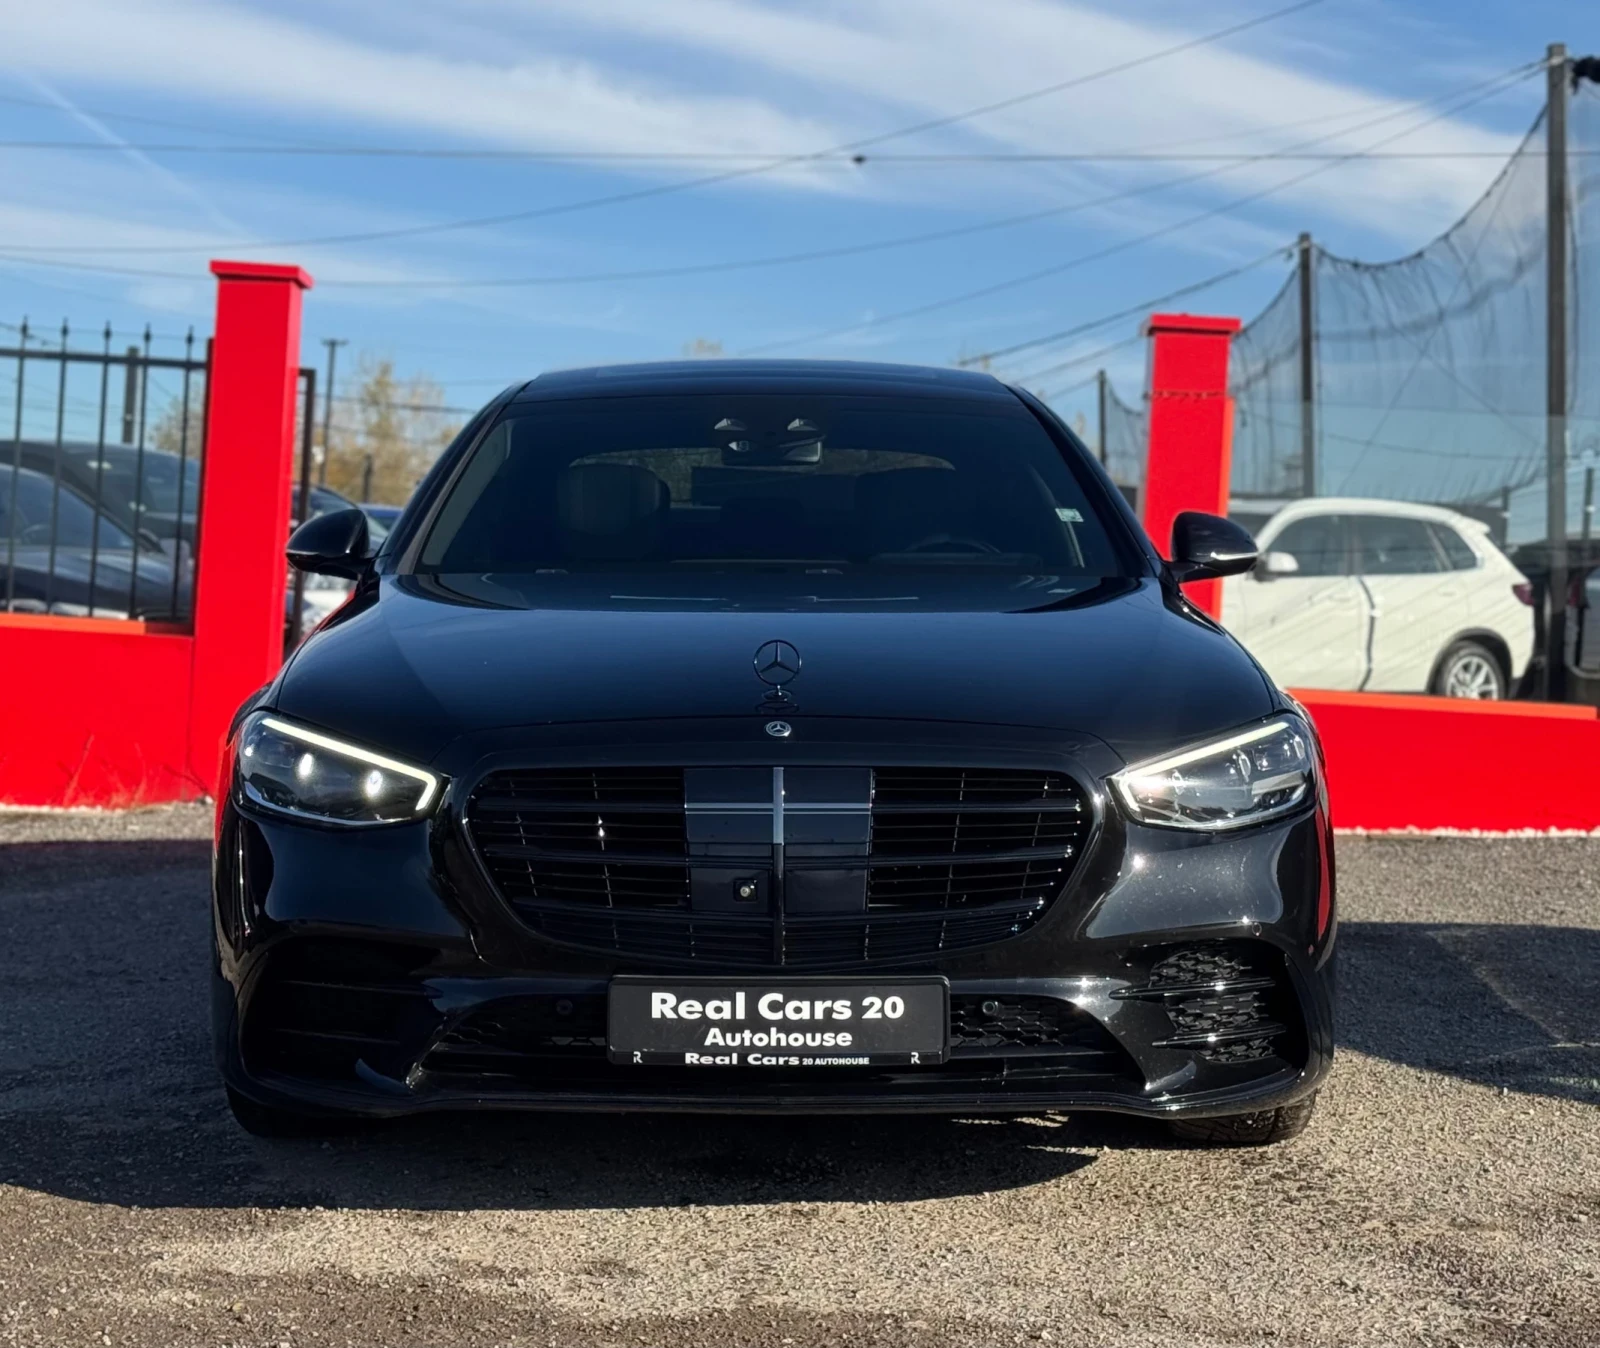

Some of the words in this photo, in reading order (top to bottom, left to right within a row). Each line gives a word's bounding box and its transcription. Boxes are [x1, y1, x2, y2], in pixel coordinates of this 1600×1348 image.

[651, 991, 746, 1020] Real
[757, 992, 853, 1021] Cars
[861, 995, 906, 1020] 20
[703, 1027, 853, 1048] Autohouse
[684, 1052, 738, 1065] Real
[747, 1053, 800, 1066] Cars
[802, 1058, 814, 1066] 20
[814, 1057, 870, 1066] AUTOHOUSE
